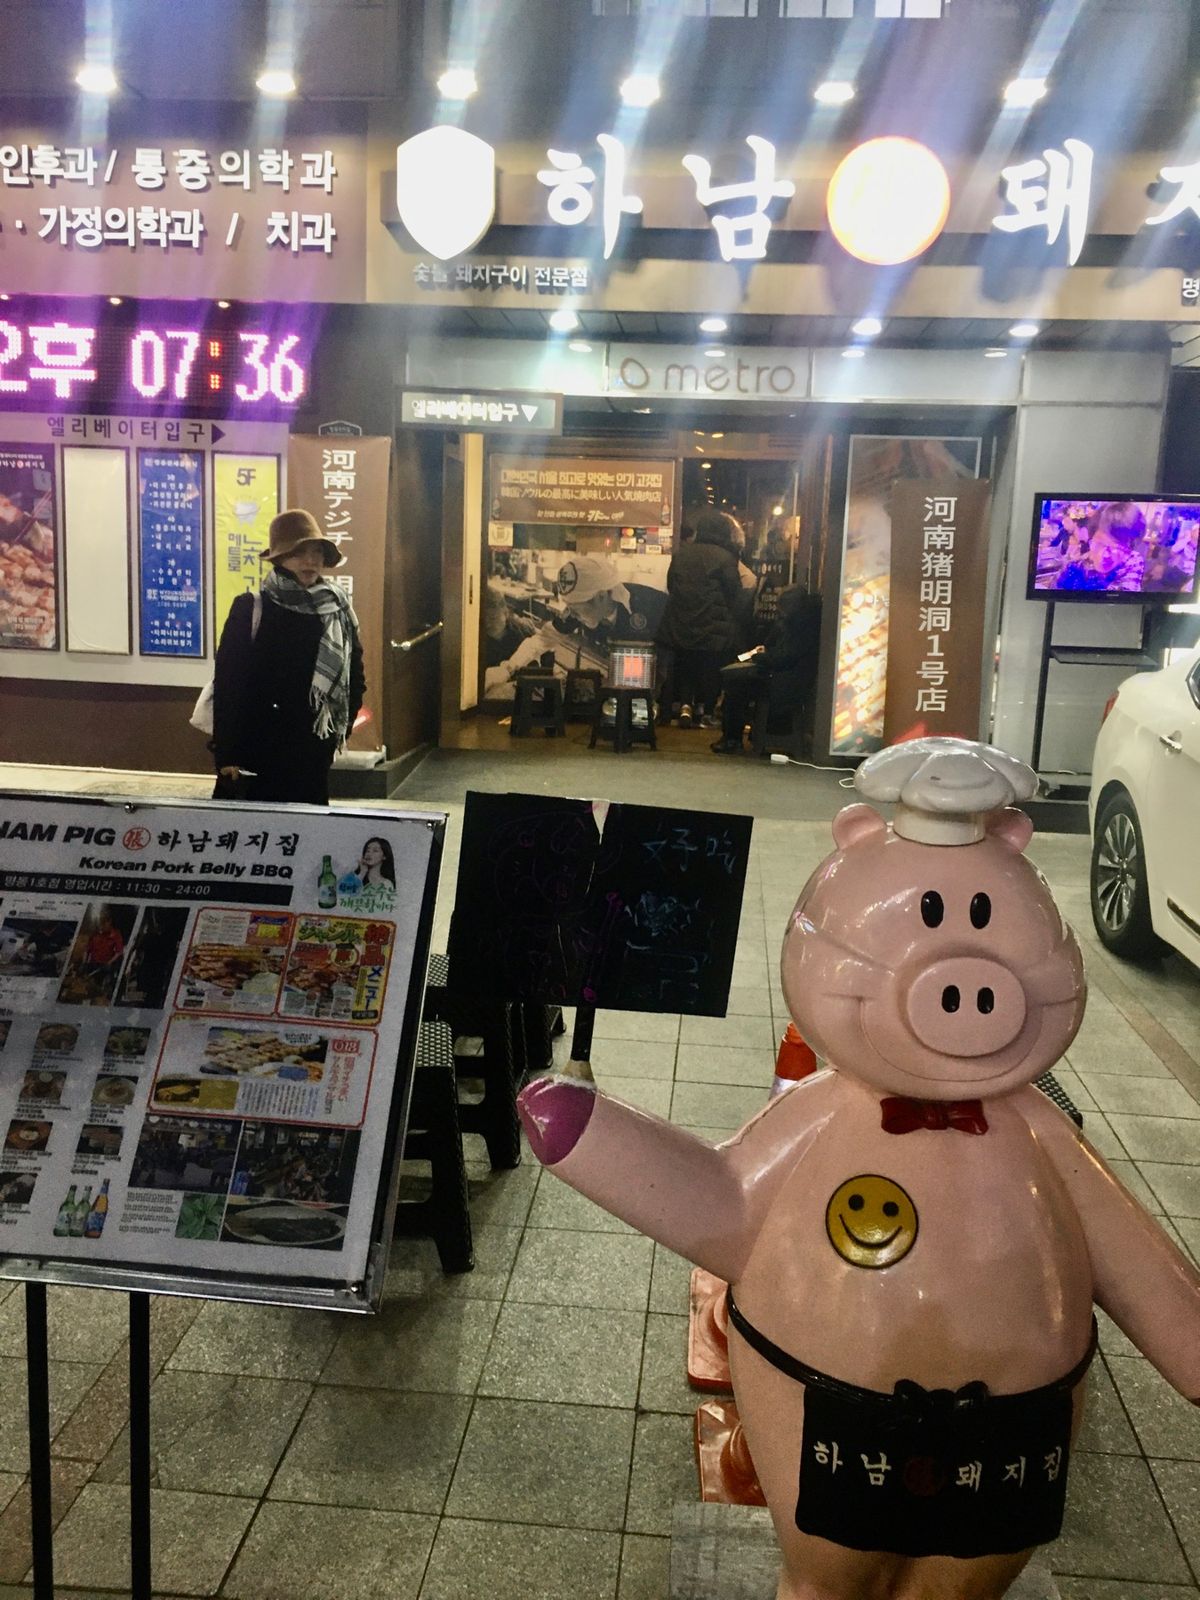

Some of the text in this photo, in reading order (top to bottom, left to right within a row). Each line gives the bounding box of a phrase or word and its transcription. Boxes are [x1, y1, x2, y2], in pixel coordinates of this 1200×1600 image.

[132, 148, 336, 191] 통증의학과
[38, 205, 204, 248] 가정의학과
[266, 211, 336, 253] 치과
[456, 264, 527, 285] 돼지구이
[535, 266, 588, 287] 전문점
[131, 329, 304, 402] 07:36
[664, 357, 797, 392] metro
[411, 399, 520, 423] 엘리베이터입구
[47, 417, 206, 445] 엘리베이터입구
[236, 467, 256, 486] 5F
[501, 470, 538, 484] 대한민국
[539, 470, 557, 485] 서울
[559, 471, 586, 486] 최고로
[588, 472, 615, 487] 맛있는
[616, 473, 635, 488] 인기
[915, 496, 958, 713] 河南猪明洞1号店
[63, 825, 116, 846] PIG
[157, 829, 299, 856] 하남돼지집
[79, 856, 293, 879] Korean Pork Belly BBQ
[64, 878, 113, 893] 영업시간
[126, 882, 161, 894] 11:30
[175, 884, 211, 896] 24:00
